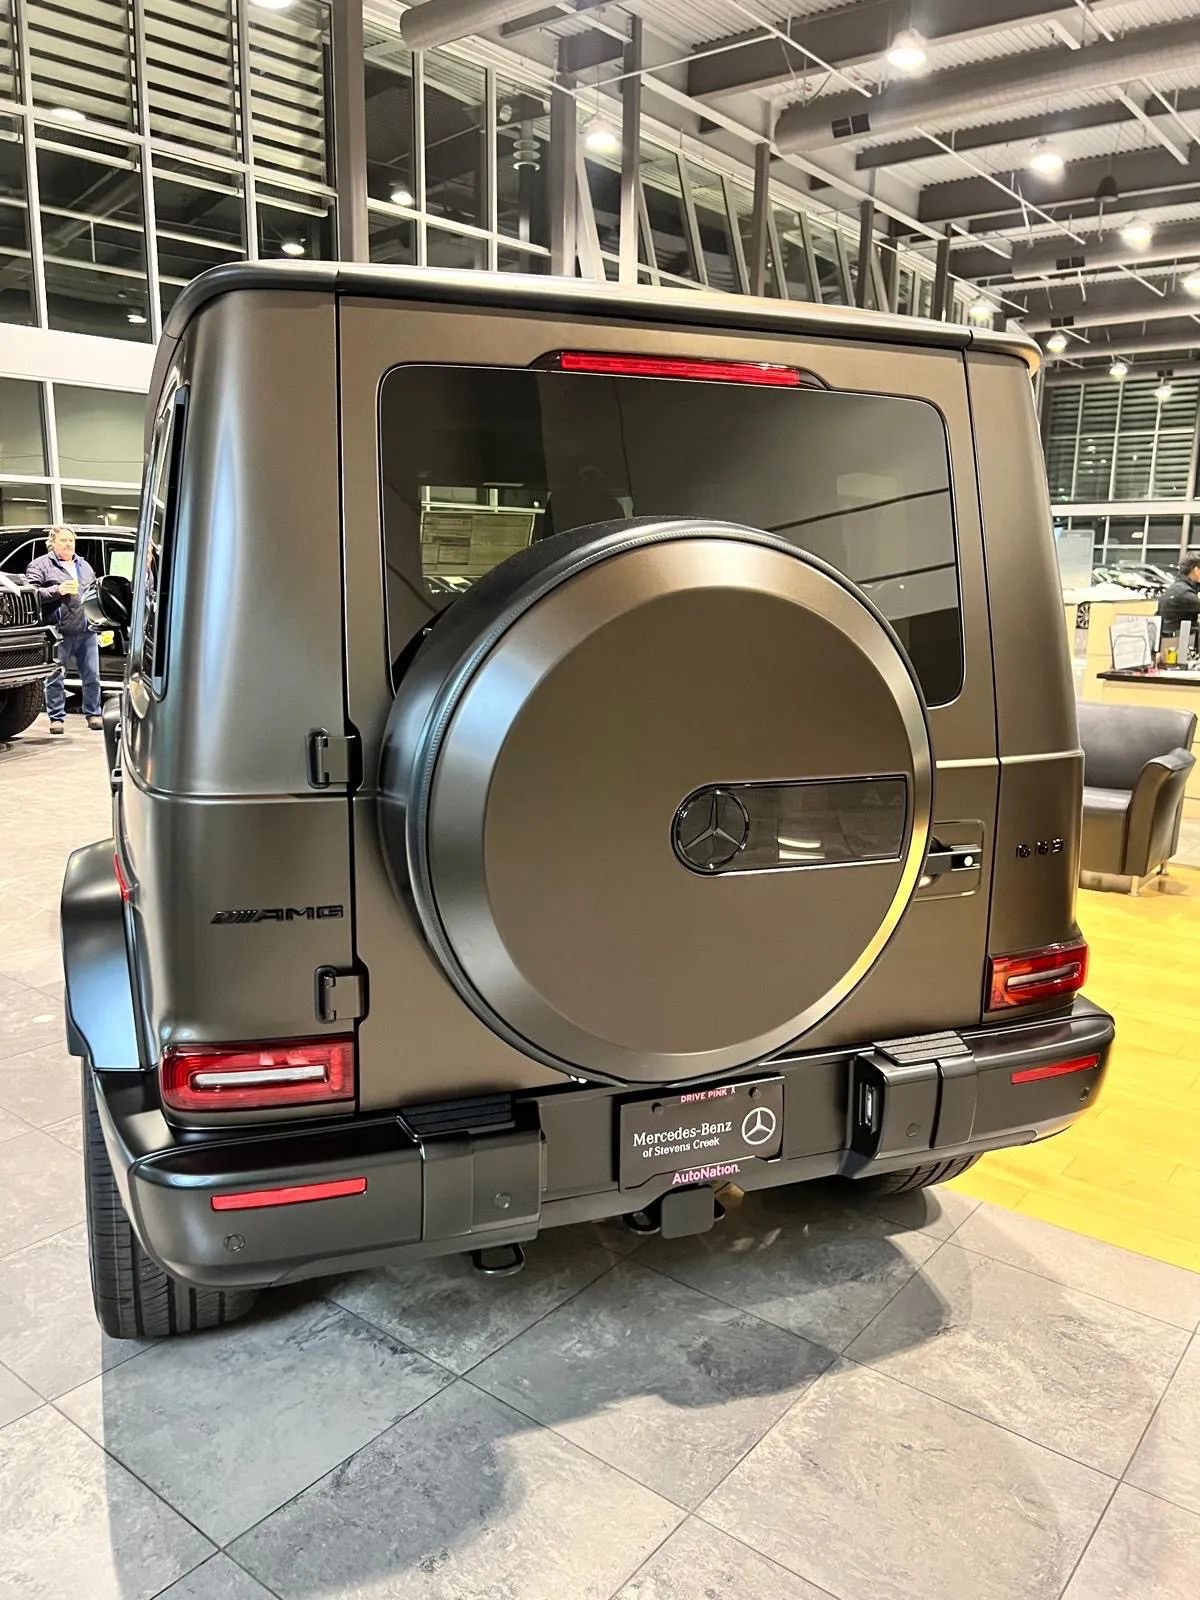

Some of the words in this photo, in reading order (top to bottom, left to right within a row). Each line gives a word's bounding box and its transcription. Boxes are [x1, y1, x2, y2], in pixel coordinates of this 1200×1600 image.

[253, 905, 344, 923] AMG
[680, 1091, 706, 1103] DRIVE
[708, 1088, 728, 1099] PINK
[633, 1121, 732, 1147] Mercedes-Benz
[642, 1148, 652, 1158] of
[654, 1143, 691, 1157] Stevens
[692, 1137, 720, 1150] Creek
